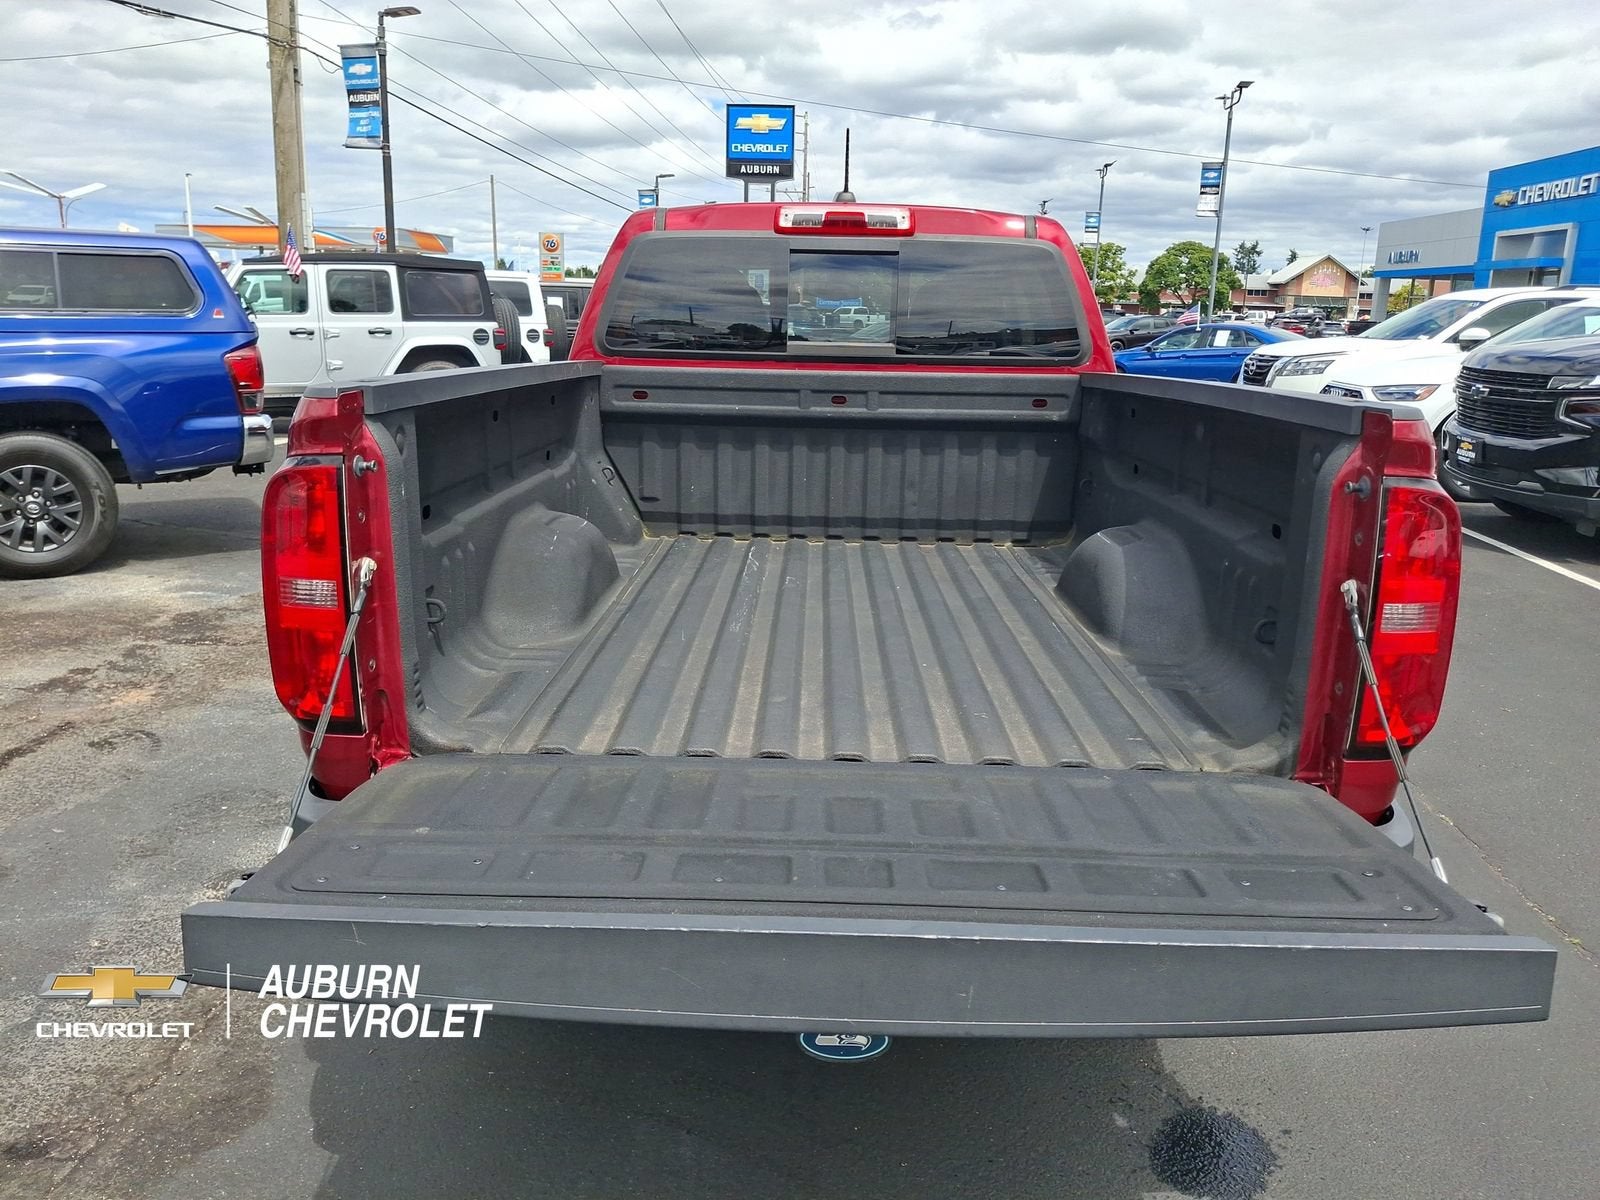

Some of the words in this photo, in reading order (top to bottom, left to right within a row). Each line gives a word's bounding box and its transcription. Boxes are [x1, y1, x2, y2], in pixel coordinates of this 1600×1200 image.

[349, 93, 380, 103] AUBURN
[731, 143, 789, 153] CHEVROLET
[740, 164, 780, 174] AUBURN
[1517, 173, 1600, 205] CHEVROLET
[545, 239, 557, 249] 76
